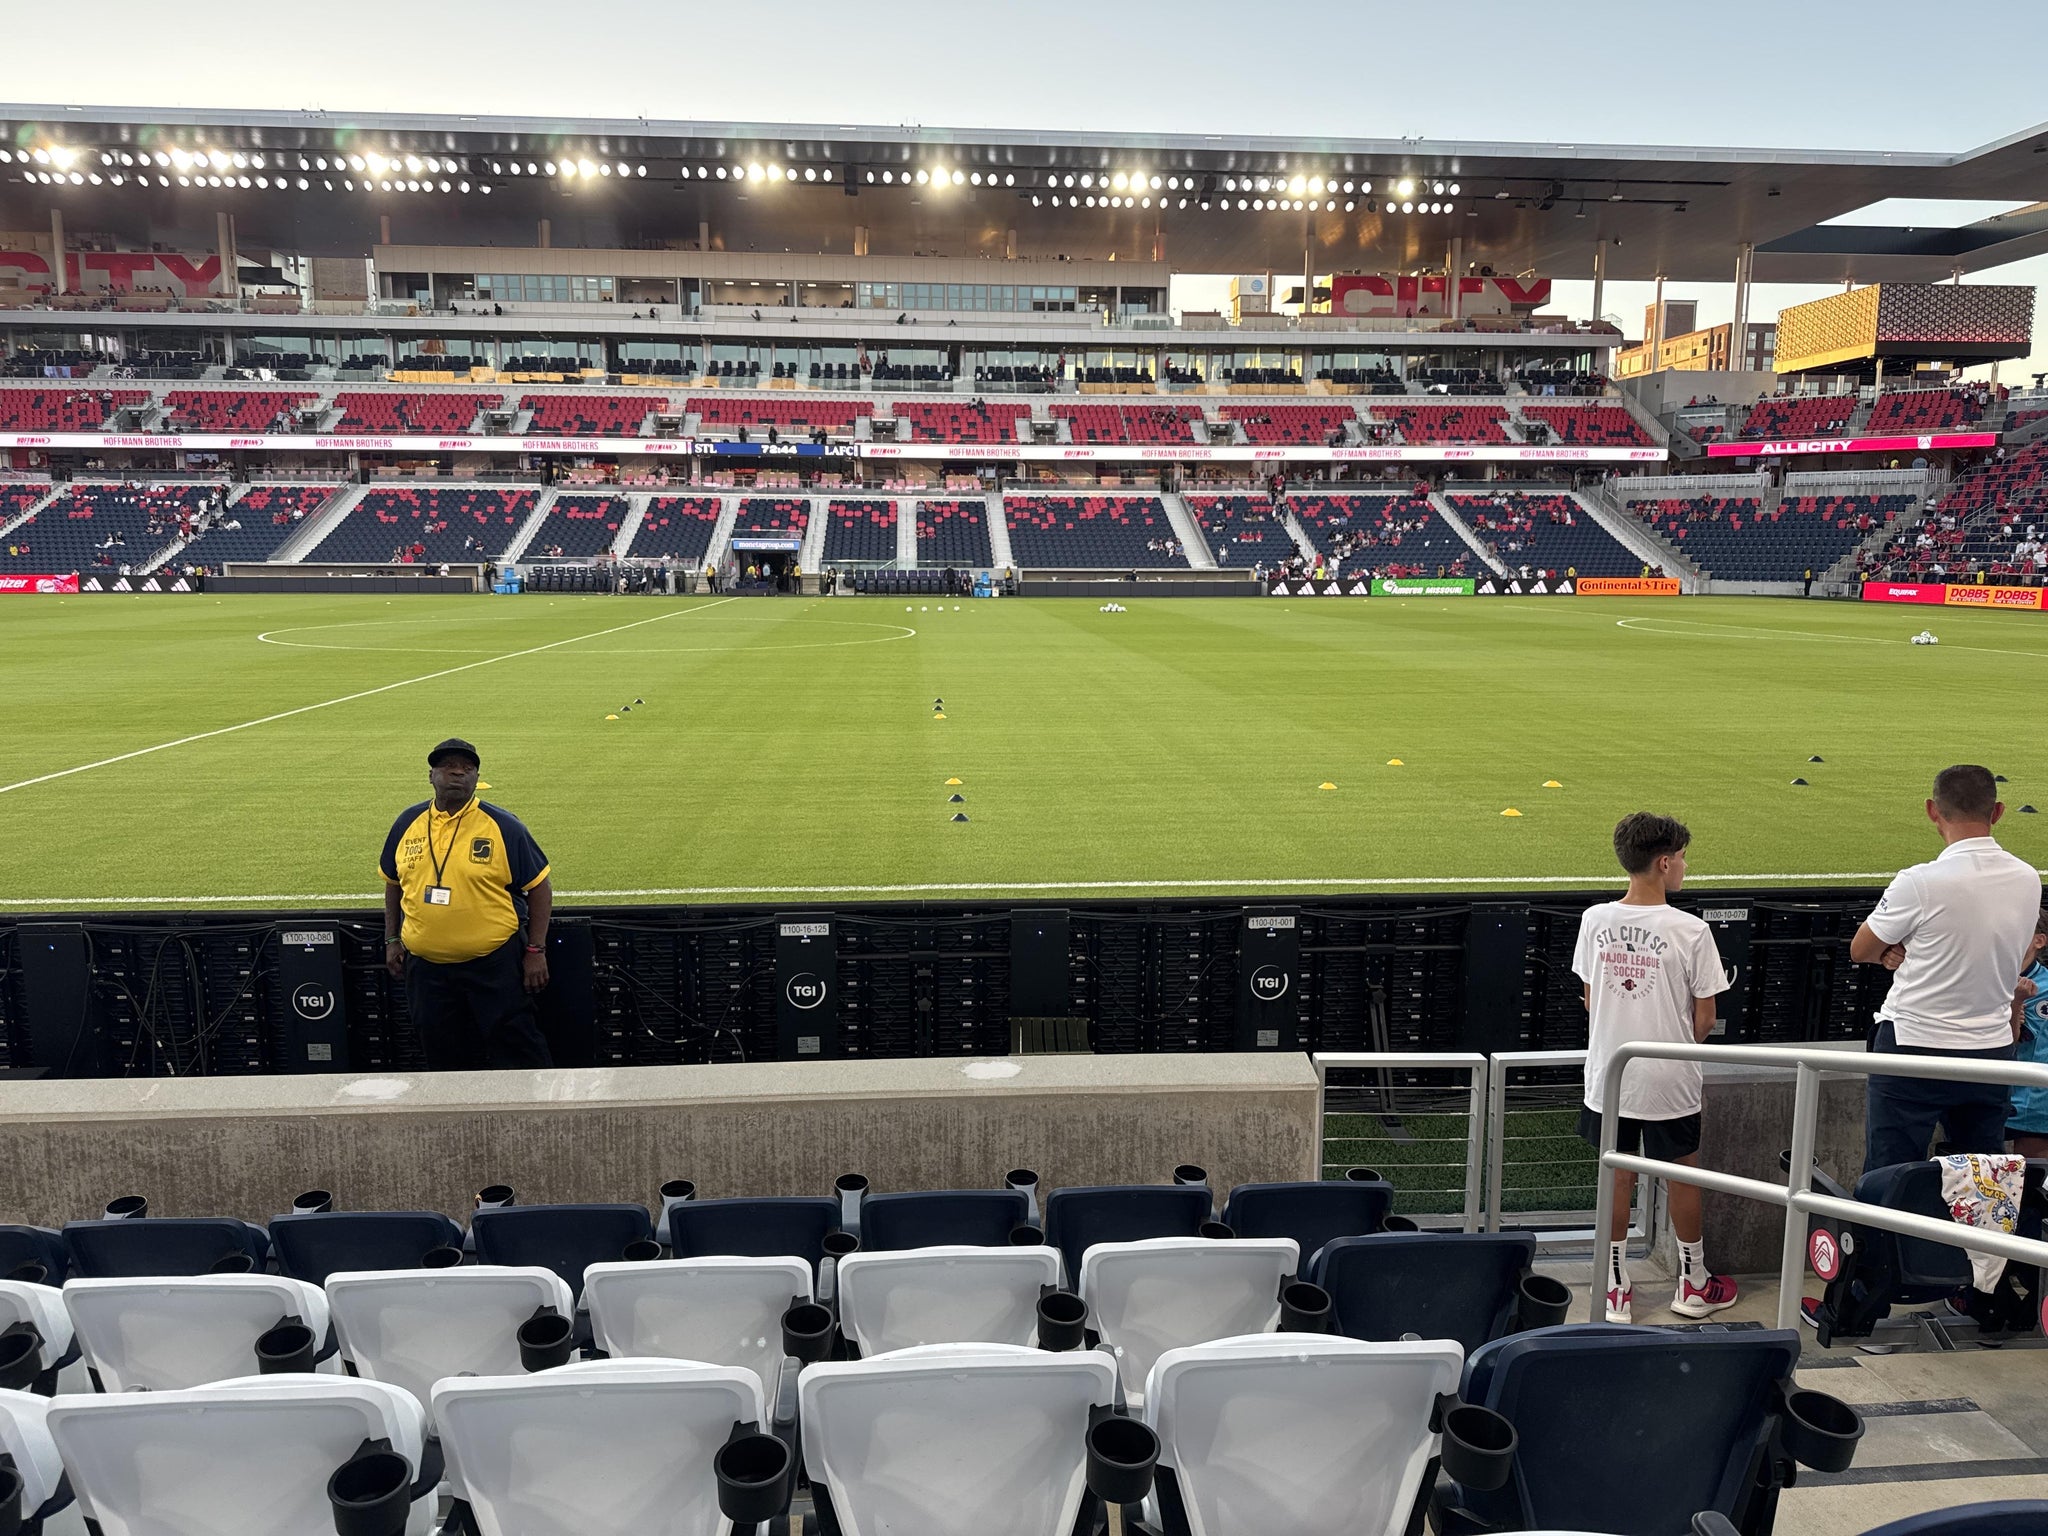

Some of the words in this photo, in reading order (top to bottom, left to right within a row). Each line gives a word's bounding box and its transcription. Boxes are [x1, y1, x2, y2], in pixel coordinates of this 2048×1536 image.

[103, 437, 143, 446] HOFFMANN
[145, 437, 182, 446] BROTHERS
[315, 439, 354, 448] HOFFMANN
[356, 439, 392, 448] BROTHERS
[523, 440, 561, 450] HOFFMANN
[562, 440, 599, 450] BROTHERS
[694, 443, 717, 454] STL
[761, 445, 797, 454] 72:44
[824, 445, 854, 456] LAFC
[949, 447, 985, 457] HOFFMANN
[986, 447, 1021, 457] BROTHERS
[1142, 450, 1177, 458] HOFFMANN
[1178, 450, 1212, 458] BROTHERS
[1332, 450, 1367, 458] HOFFMANN
[1368, 450, 1402, 458] BROTHERS
[1519, 450, 1555, 458] HOFFMANN
[1556, 450, 1589, 458] BROTHERS
[1579, 580, 1641, 591] Continental
[1651, 580, 1677, 591] Tire
[1425, 586, 1463, 595] MISSOURI
[1888, 588, 1918, 597] EQUIFAX
[1950, 588, 1990, 598] DOBBS
[1995, 590, 2037, 601] DOBBS
[405, 837, 427, 846] EVENT
[403, 855, 424, 864] STAFF
[1705, 910, 1746, 919] 1100-10-079
[1251, 918, 1293, 927] 1100-01-001
[782, 925, 828, 934] 1100-16-125
[286, 933, 332, 942] 1100-10-080
[1596, 928, 1618, 949] STL
[1620, 925, 1651, 945] CITY
[1650, 936, 1668, 956] SC
[1600, 952, 1628, 965] MAJOR
[1631, 954, 1661, 969] LEAGUE
[1613, 965, 1646, 979] SOCCER
[1257, 977, 1279, 988] TGI
[793, 985, 816, 997] TGI
[300, 996, 325, 1007] TGI
